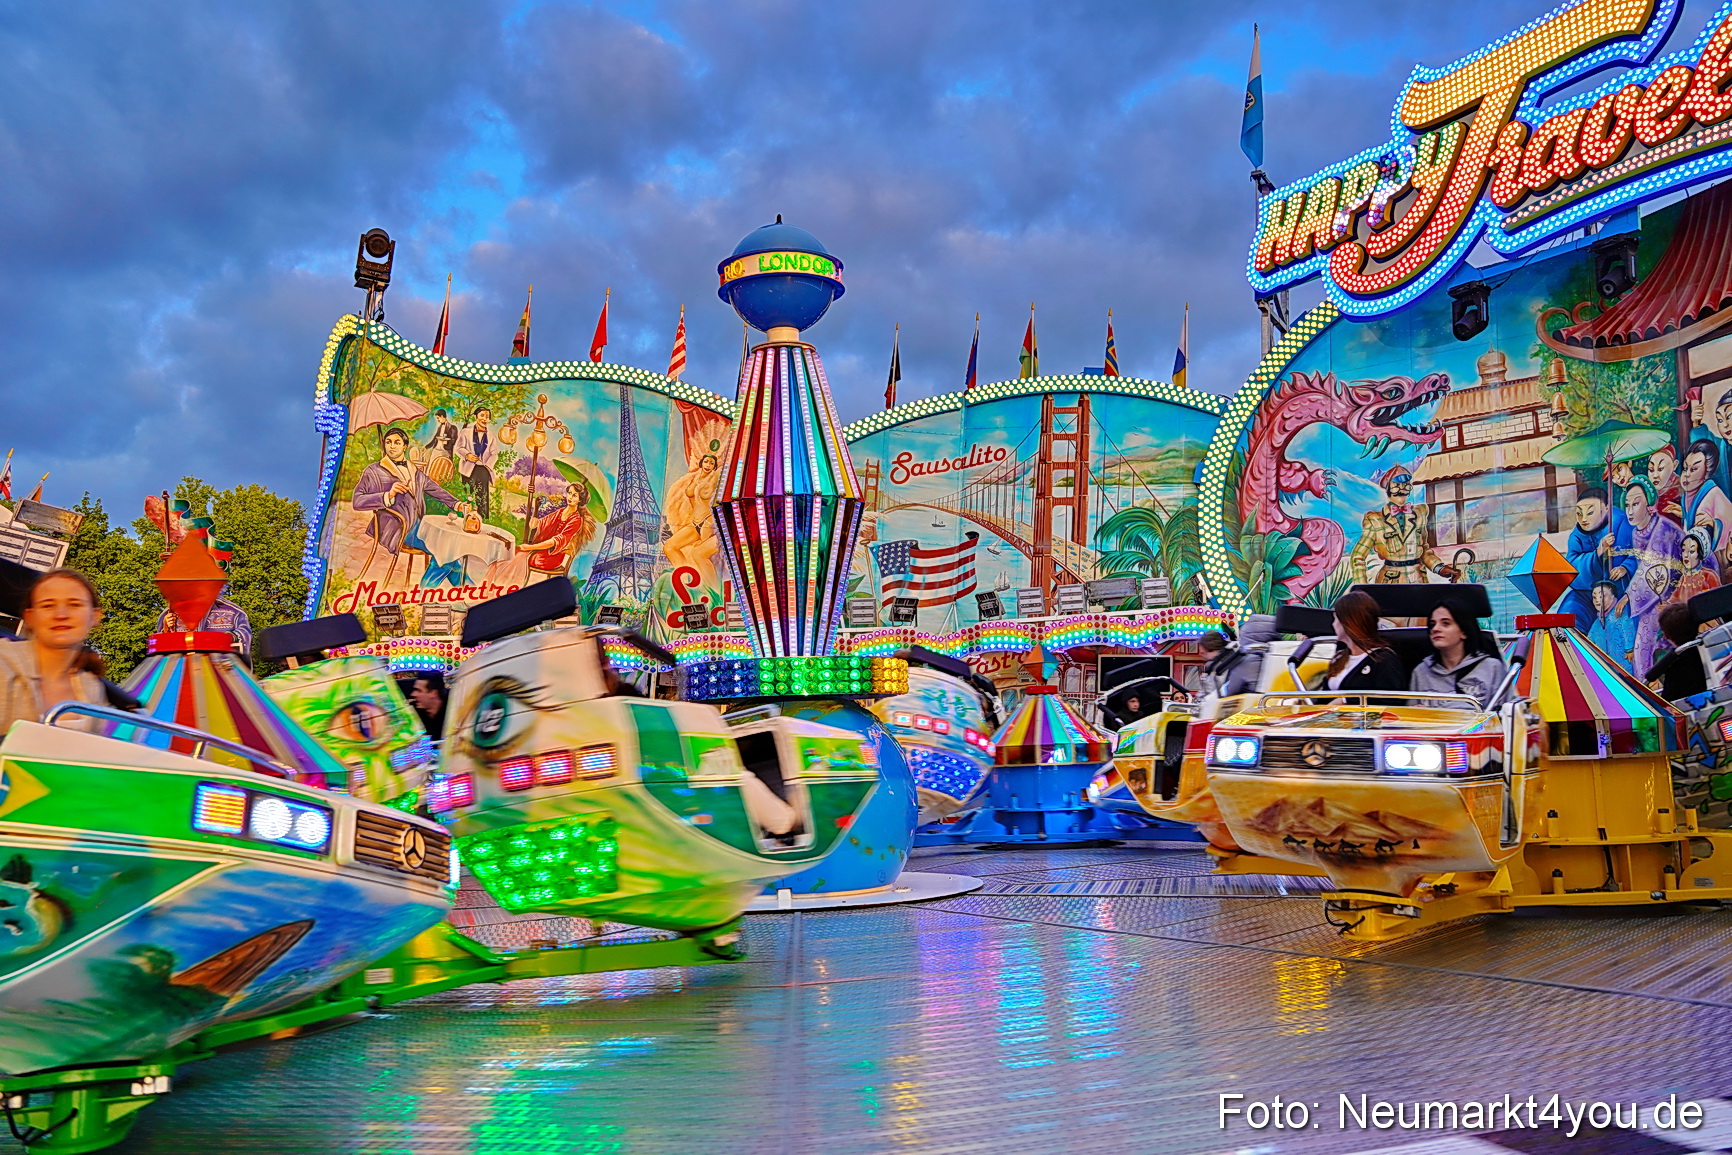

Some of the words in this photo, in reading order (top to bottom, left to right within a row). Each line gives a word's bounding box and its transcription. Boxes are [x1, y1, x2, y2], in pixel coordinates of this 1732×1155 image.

[1255, 120, 1467, 272] HAPPY
[723, 259, 744, 281] RIO
[759, 253, 833, 275] LONDON
[890, 443, 1007, 485] Sausalito
[333, 580, 520, 615] Montmartre
